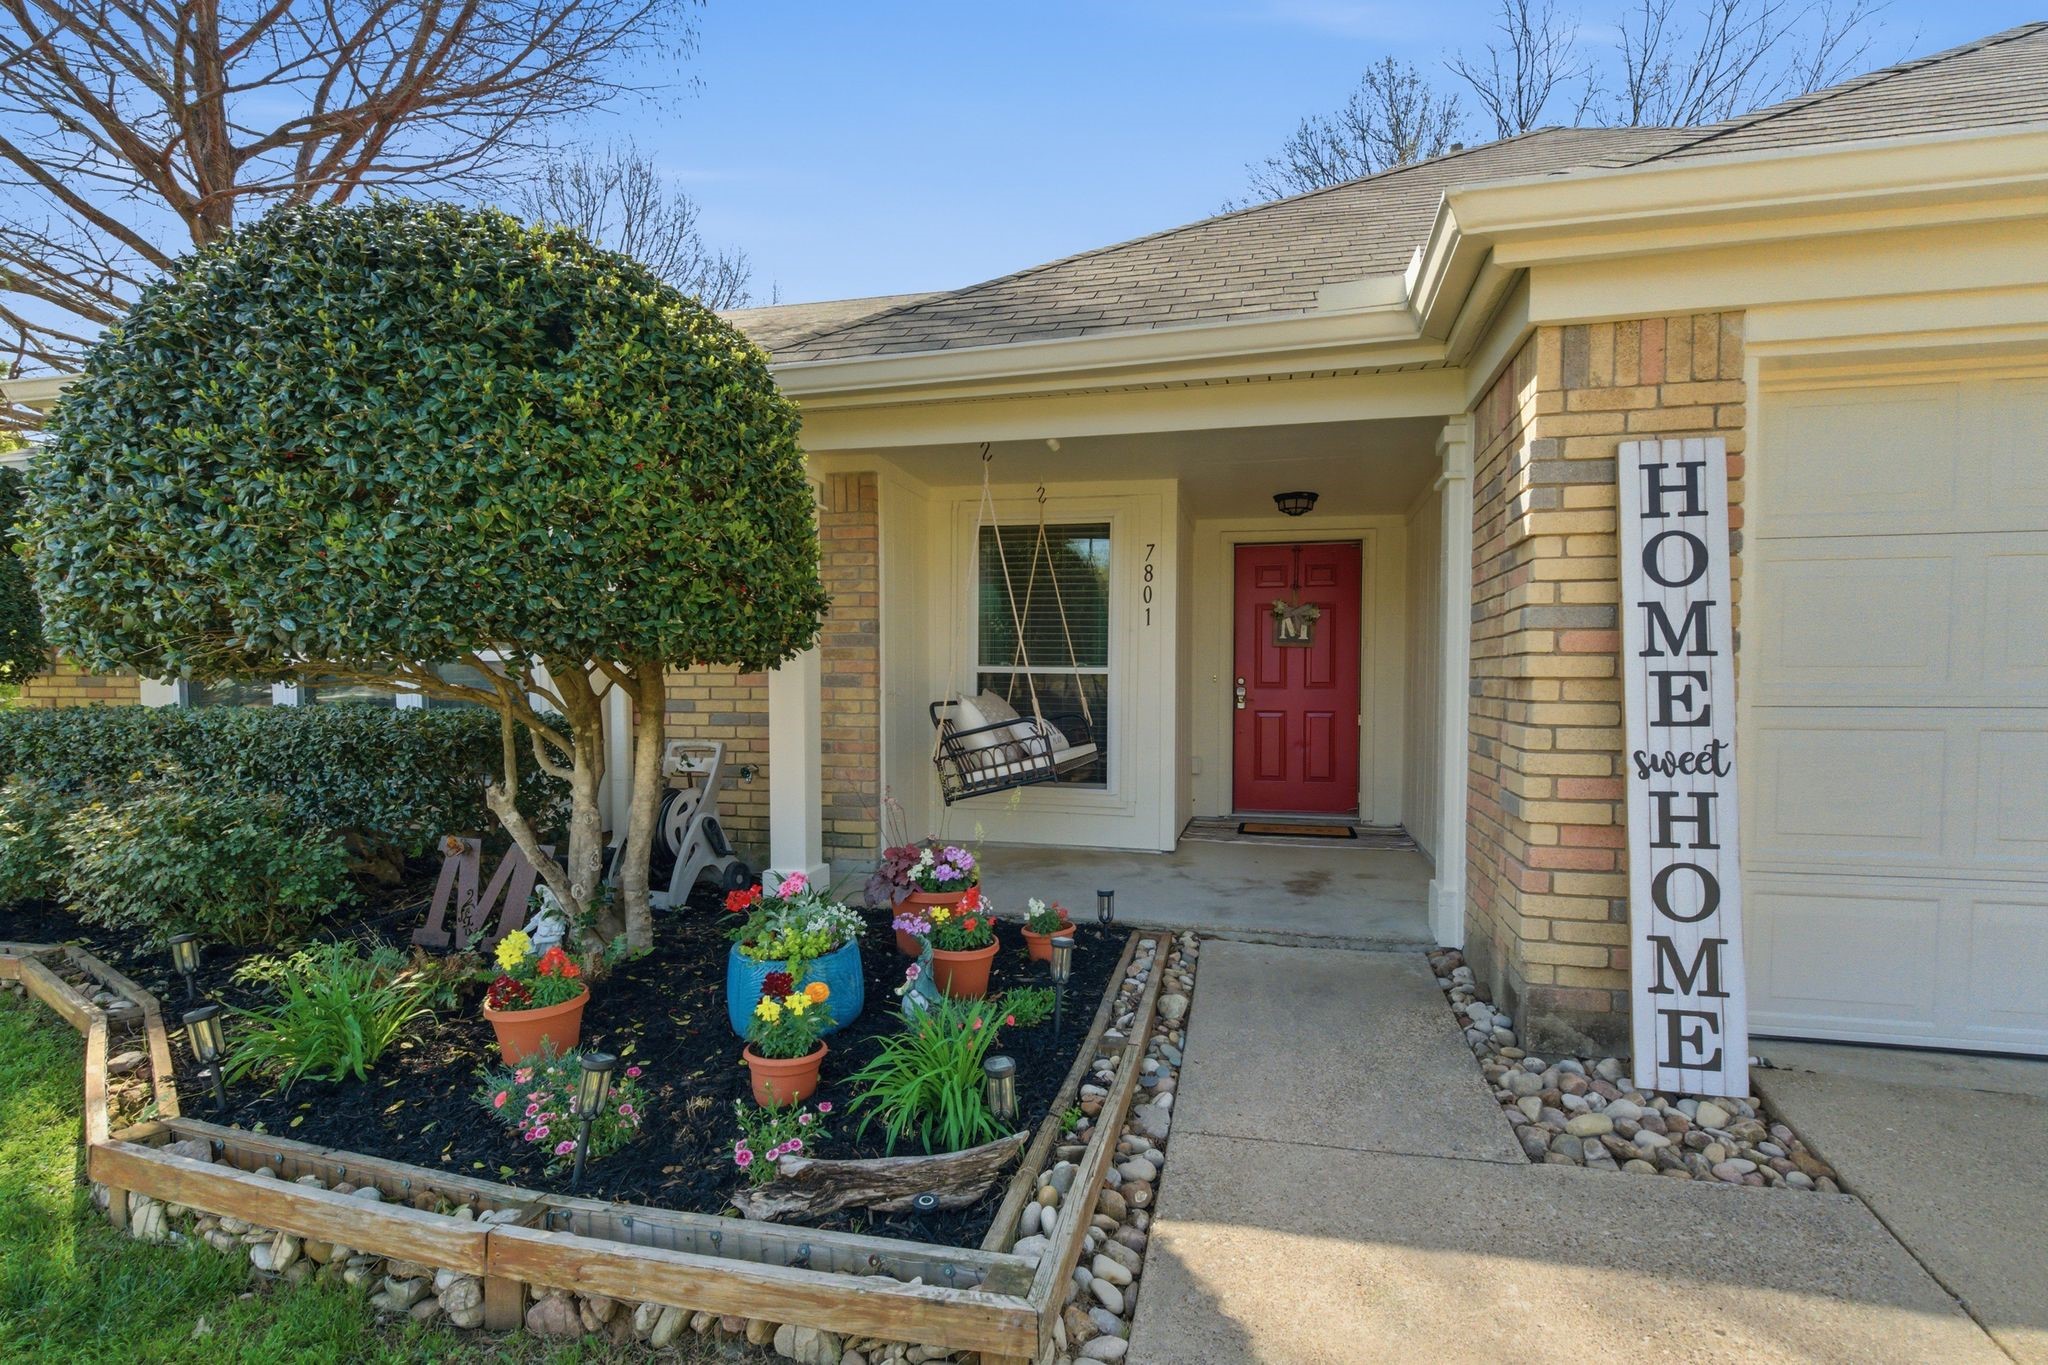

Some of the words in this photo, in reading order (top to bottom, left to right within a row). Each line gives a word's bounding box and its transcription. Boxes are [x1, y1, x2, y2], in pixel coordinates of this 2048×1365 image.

[1143, 543, 1156, 626] 7801
[1279, 617, 1309, 640] M
[1638, 461, 1718, 727] HOME
[1633, 738, 1732, 781] sweet
[411, 835, 556, 951] M
[1647, 791, 1731, 1071] HOME
